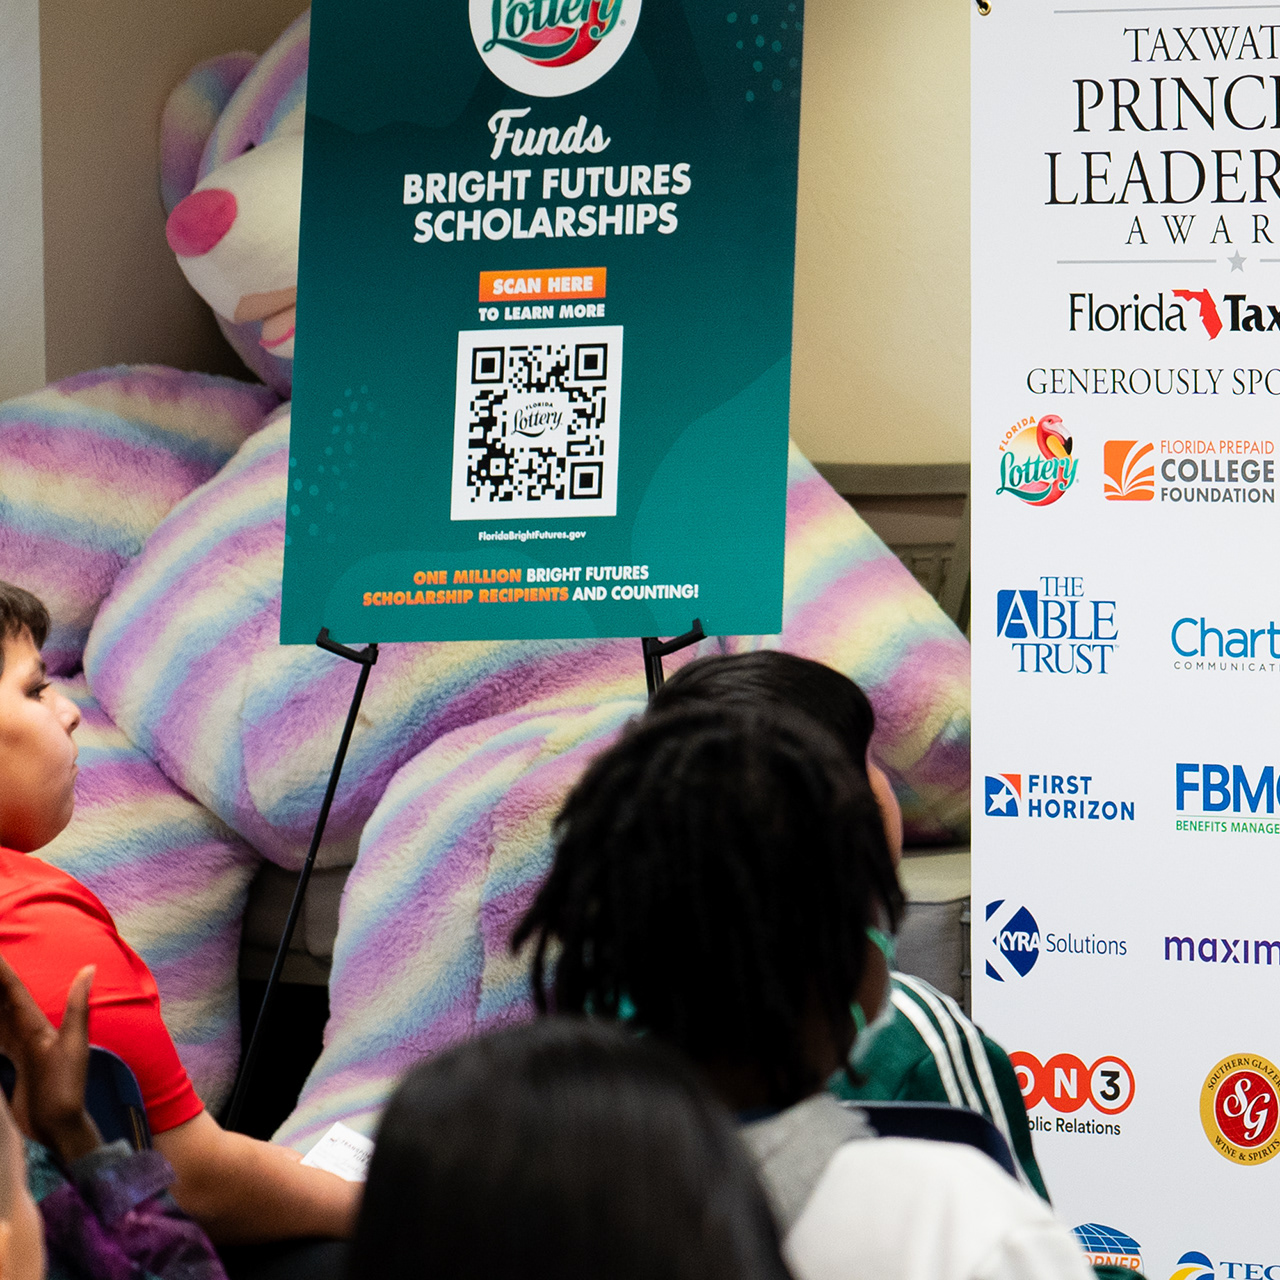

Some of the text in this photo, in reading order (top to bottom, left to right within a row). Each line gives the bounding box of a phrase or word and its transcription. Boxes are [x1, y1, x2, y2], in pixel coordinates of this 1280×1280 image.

[487, 107, 611, 160] Funds
[403, 163, 691, 204] BRIGHT FUTURES
[413, 202, 678, 243] SCHOLARSHIPS
[493, 276, 593, 295] SCAN HERE
[478, 303, 605, 321] TO LEARN MORE
[1069, 293, 1187, 332] Florida
[1026, 368, 1223, 396] GENEROUSLY
[510, 409, 563, 438] Lottery
[999, 416, 1036, 452] FLORIDA
[1160, 440, 1274, 454] FLORIDA PREPAID
[996, 451, 1079, 501] Lottery
[1161, 458, 1274, 483] COLLEGE
[1161, 487, 1275, 503] FOUNDATION
[478, 530, 586, 542] FloridaBrightFutures.gov
[413, 565, 649, 585] ONE MILLION BRIGHT FUTURES
[1040, 576, 1084, 597] THE
[363, 584, 699, 606] SCHOLARSHIP RECIPIENTS AND COUNTING!
[997, 589, 1119, 640] ABLE
[1011, 643, 1115, 674] TRUST
[1028, 775, 1092, 796] FIRST
[1028, 798, 1135, 821] HORIZON
[1176, 820, 1228, 834] BENEFITS
[997, 930, 1127, 956] KYRA Solutions
[1207, 1058, 1250, 1090] SOUTHERN
[1026, 1116, 1120, 1135] blic Relations
[1215, 1135, 1280, 1161] WINE & SPIRITS
